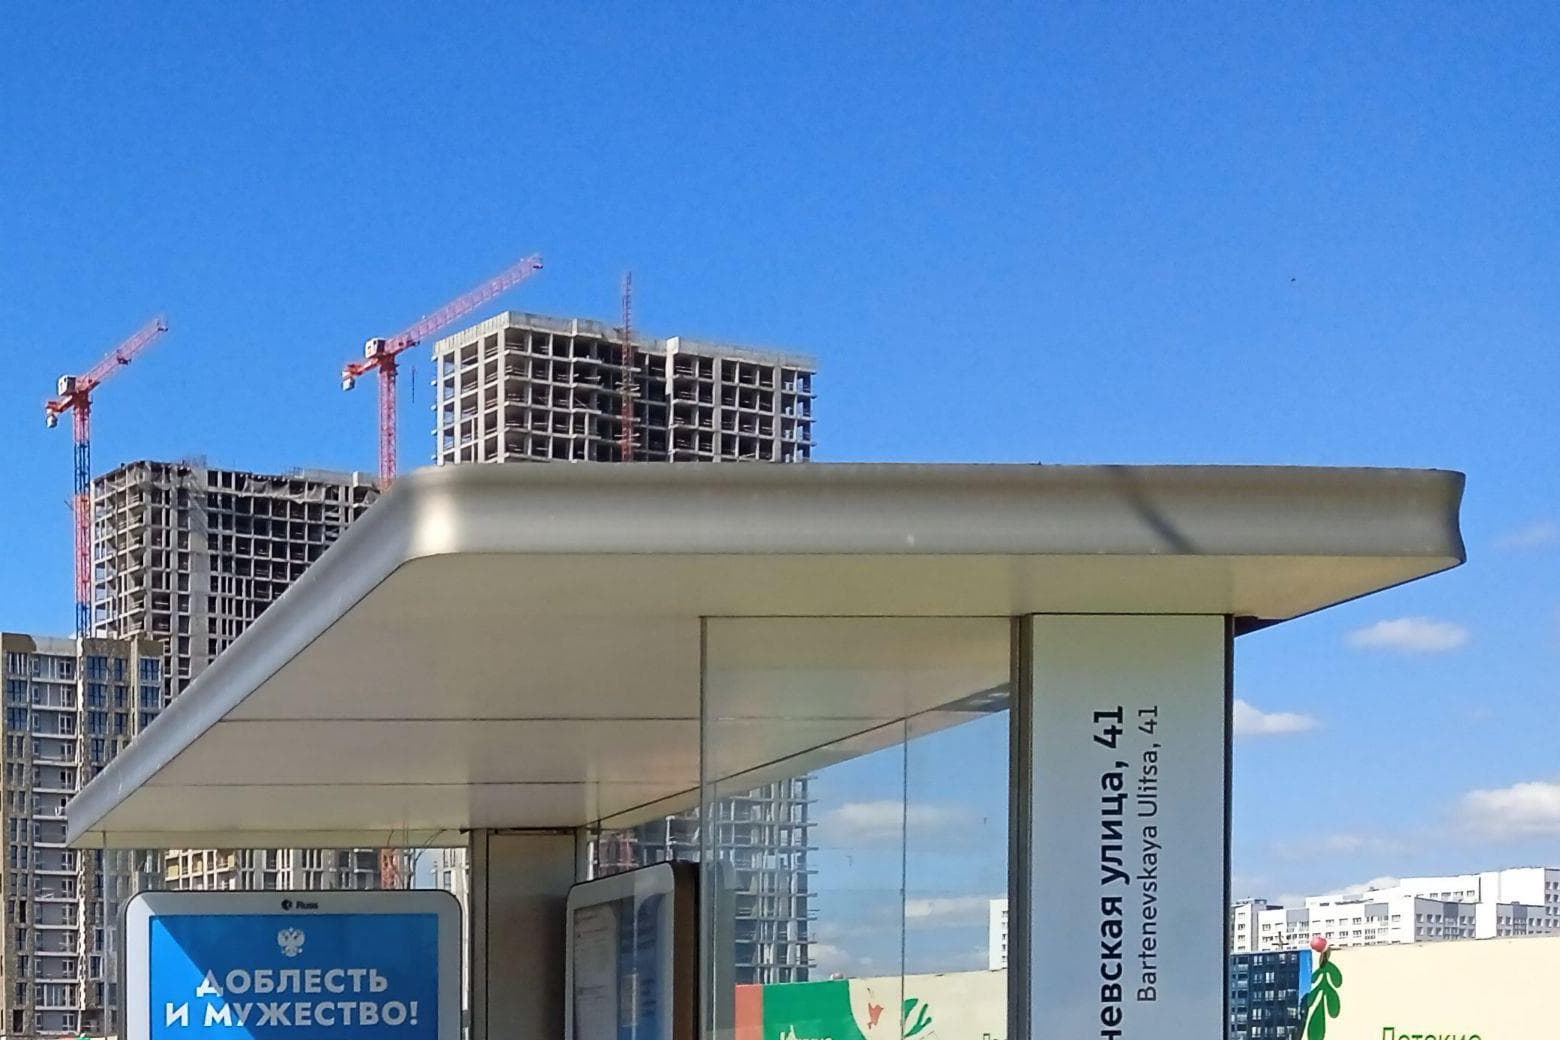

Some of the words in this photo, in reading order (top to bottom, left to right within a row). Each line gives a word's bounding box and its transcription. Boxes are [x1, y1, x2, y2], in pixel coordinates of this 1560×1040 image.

[1093, 705, 1123, 749] 41
[1138, 705, 1158, 735] 41
[1136, 743, 1162, 817] Ulitsa,
[1101, 760, 1130, 886] улица,
[1137, 825, 1162, 1002] Bartenevskaya
[196, 968, 389, 998] ДОБЛЕСТЬ
[165, 1002, 189, 1028] И
[204, 1000, 418, 1027] МУЖЕСТВО!
